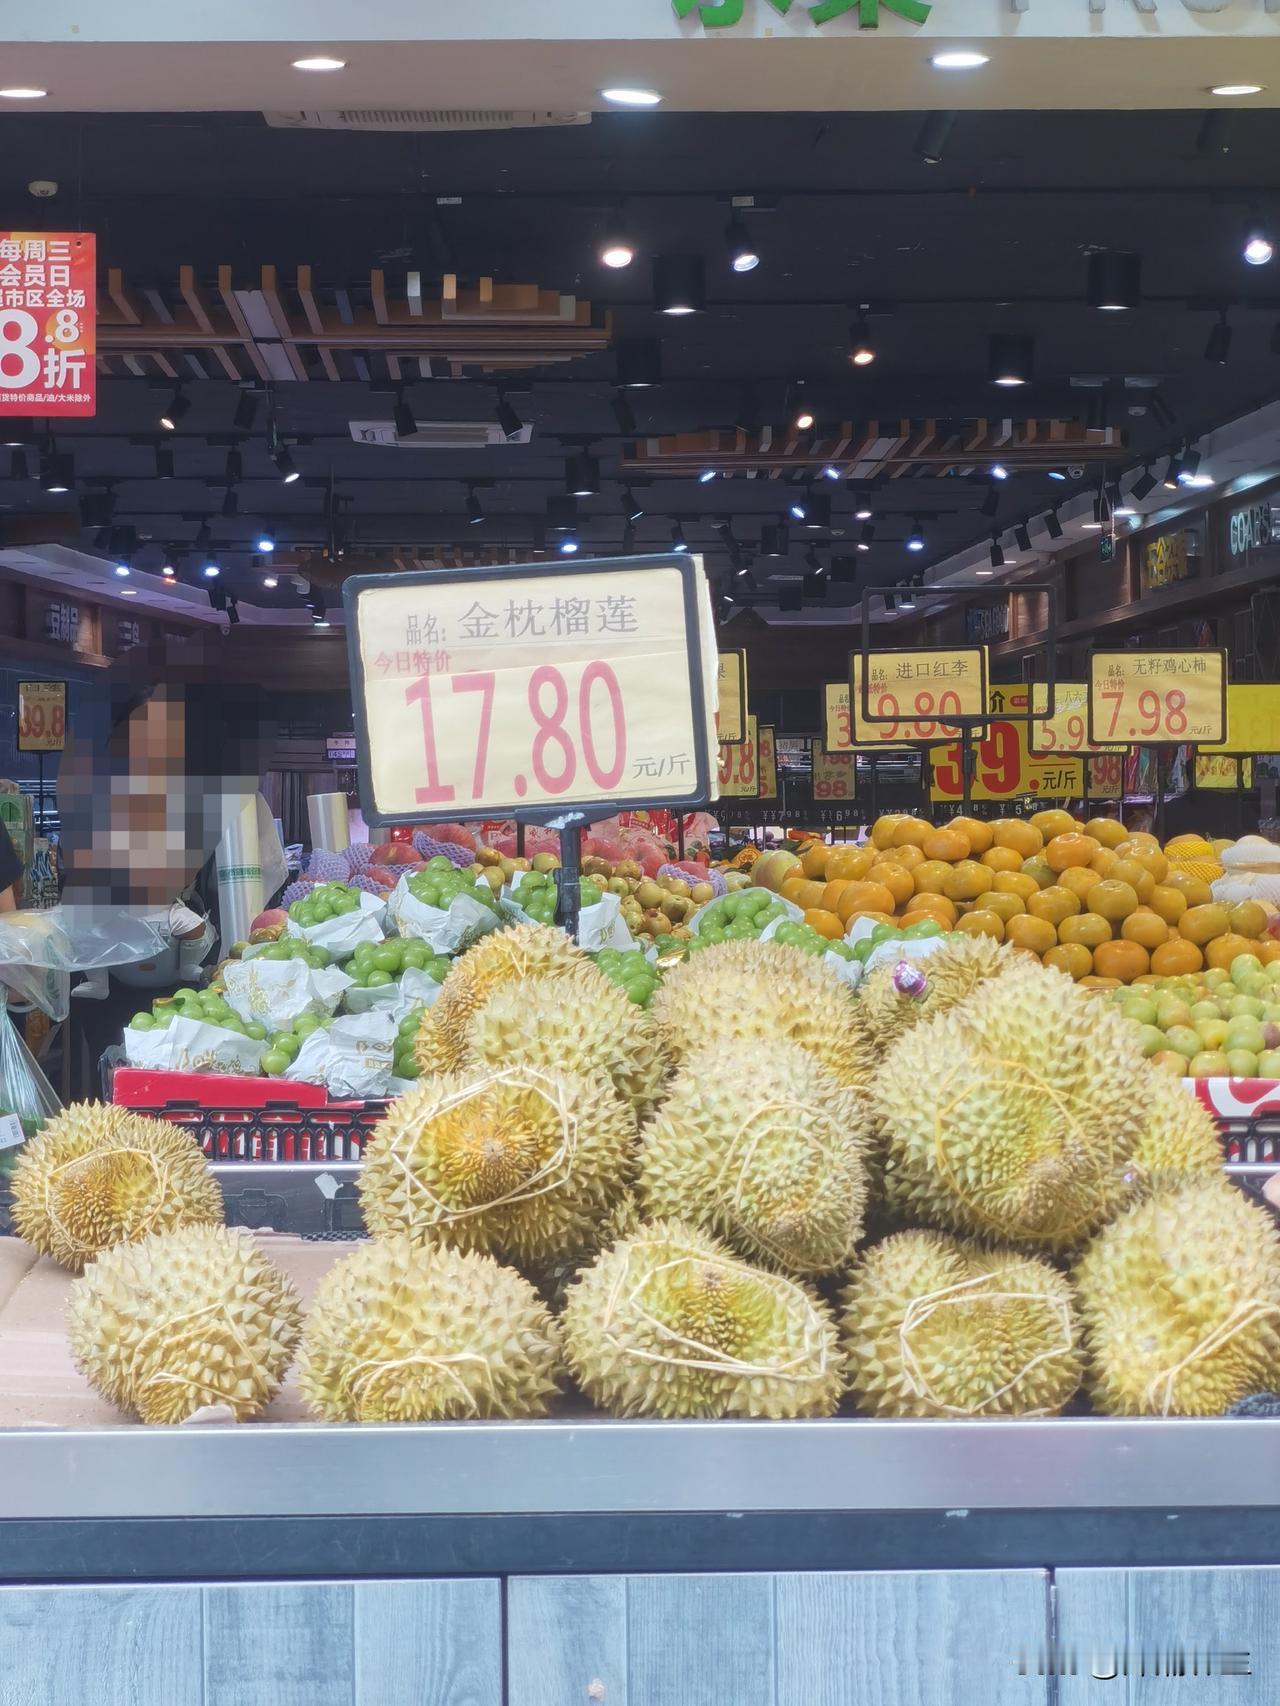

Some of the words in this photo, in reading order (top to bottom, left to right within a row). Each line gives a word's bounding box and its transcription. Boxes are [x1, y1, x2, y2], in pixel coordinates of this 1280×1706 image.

[0, 239, 72, 262] 每周三
[0, 263, 70, 288] 会员日
[0, 289, 86, 308] 市区全场
[457, 595, 640, 641] 金枕榴莲
[373, 649, 452, 675] 今日特价
[895, 659, 969, 680] 进口红李
[1132, 656, 1207, 676] 无籽鸡心柿
[1094, 679, 1126, 691] 今日特价
[877, 690, 962, 740] 9.80
[1100, 688, 1189, 737] 7.98
[1188, 725, 1213, 735] 元/斤
[404, 660, 628, 805] 17.80
[632, 752, 692, 781] 元/斤
[1042, 770, 1077, 790] 元/斤
